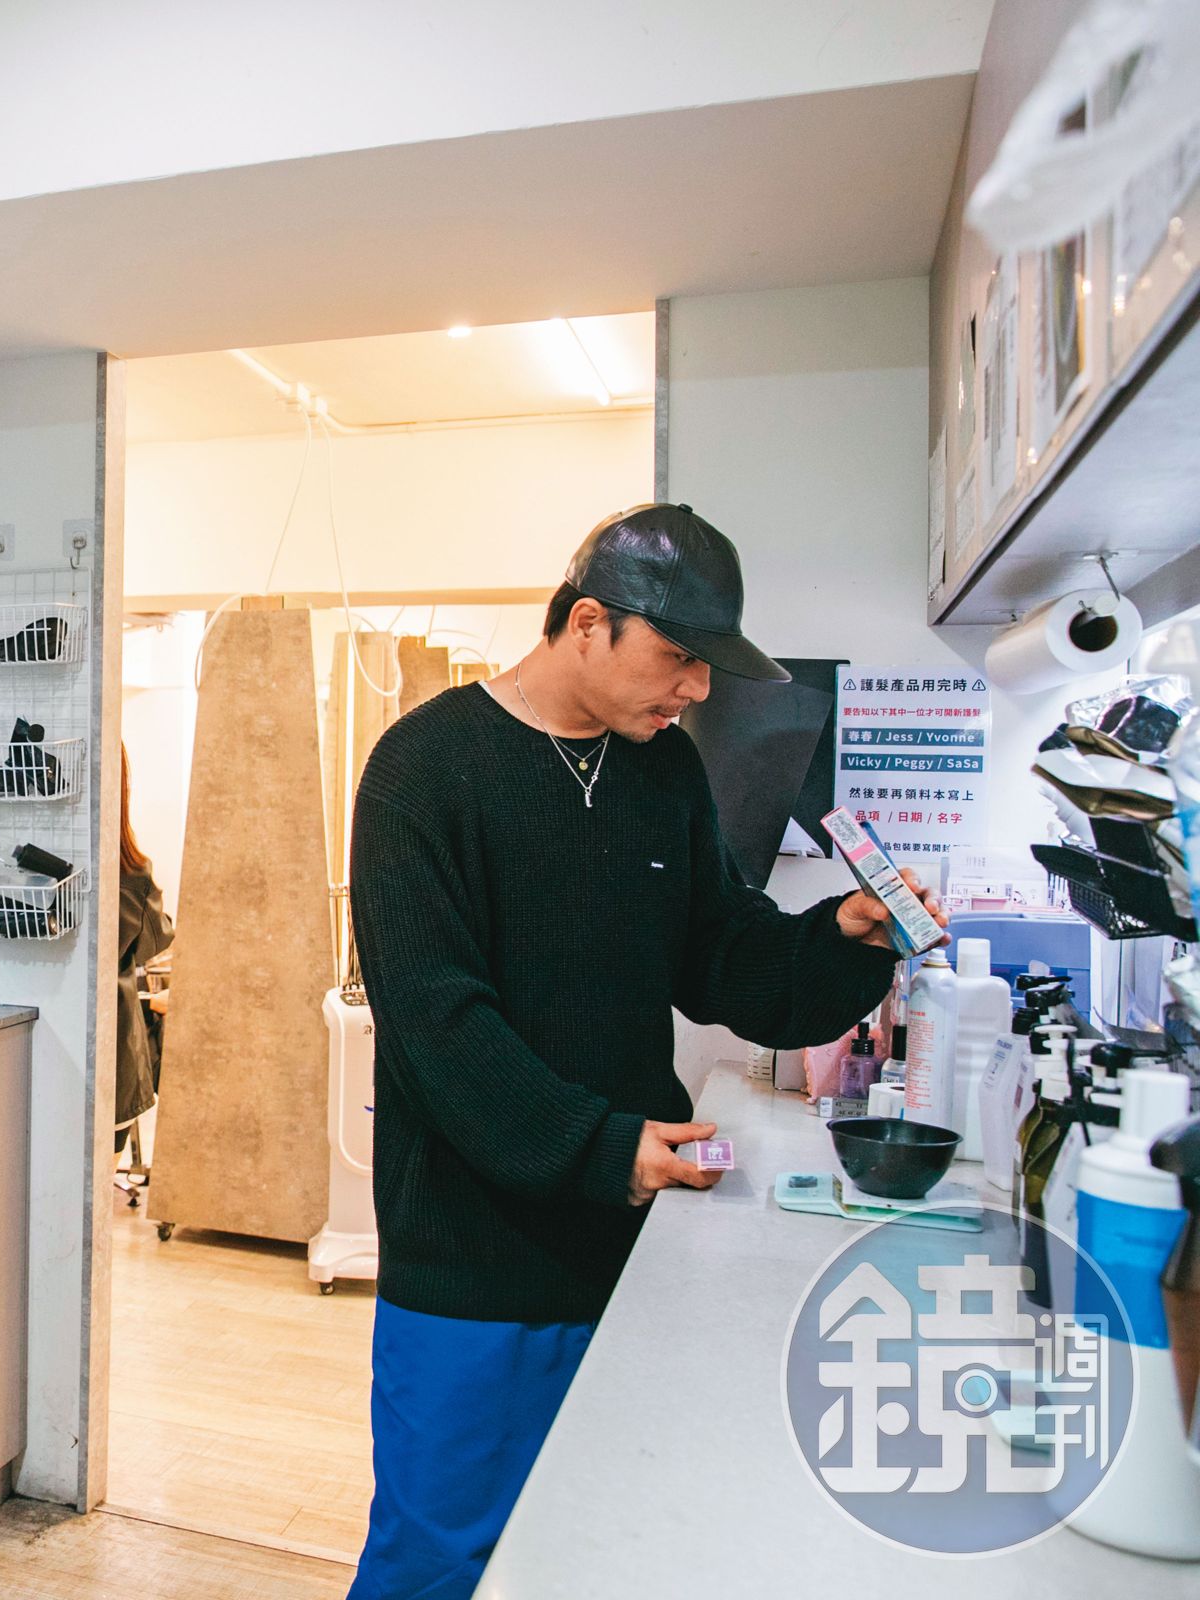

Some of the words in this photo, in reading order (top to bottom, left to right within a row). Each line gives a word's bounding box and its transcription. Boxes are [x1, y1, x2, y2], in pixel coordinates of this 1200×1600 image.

[860, 678, 967, 692] 護髮產品用完時
[848, 730, 873, 742] 春春
[876, 732, 882, 743] /
[885, 732, 914, 742] Jess
[917, 732, 923, 744] /
[926, 732, 975, 743] Yvonne
[847, 757, 882, 769] Vicky
[885, 757, 891, 769] /
[894, 757, 934, 770] Peggy
[937, 758, 943, 770] /
[947, 758, 979, 769] SaSa
[849, 787, 975, 801] 然後要再領料本寫上
[855, 810, 880, 822] 品項
[887, 811, 893, 823] /
[898, 811, 923, 823] 日期
[927, 812, 933, 824] /
[937, 812, 963, 825] 名字
